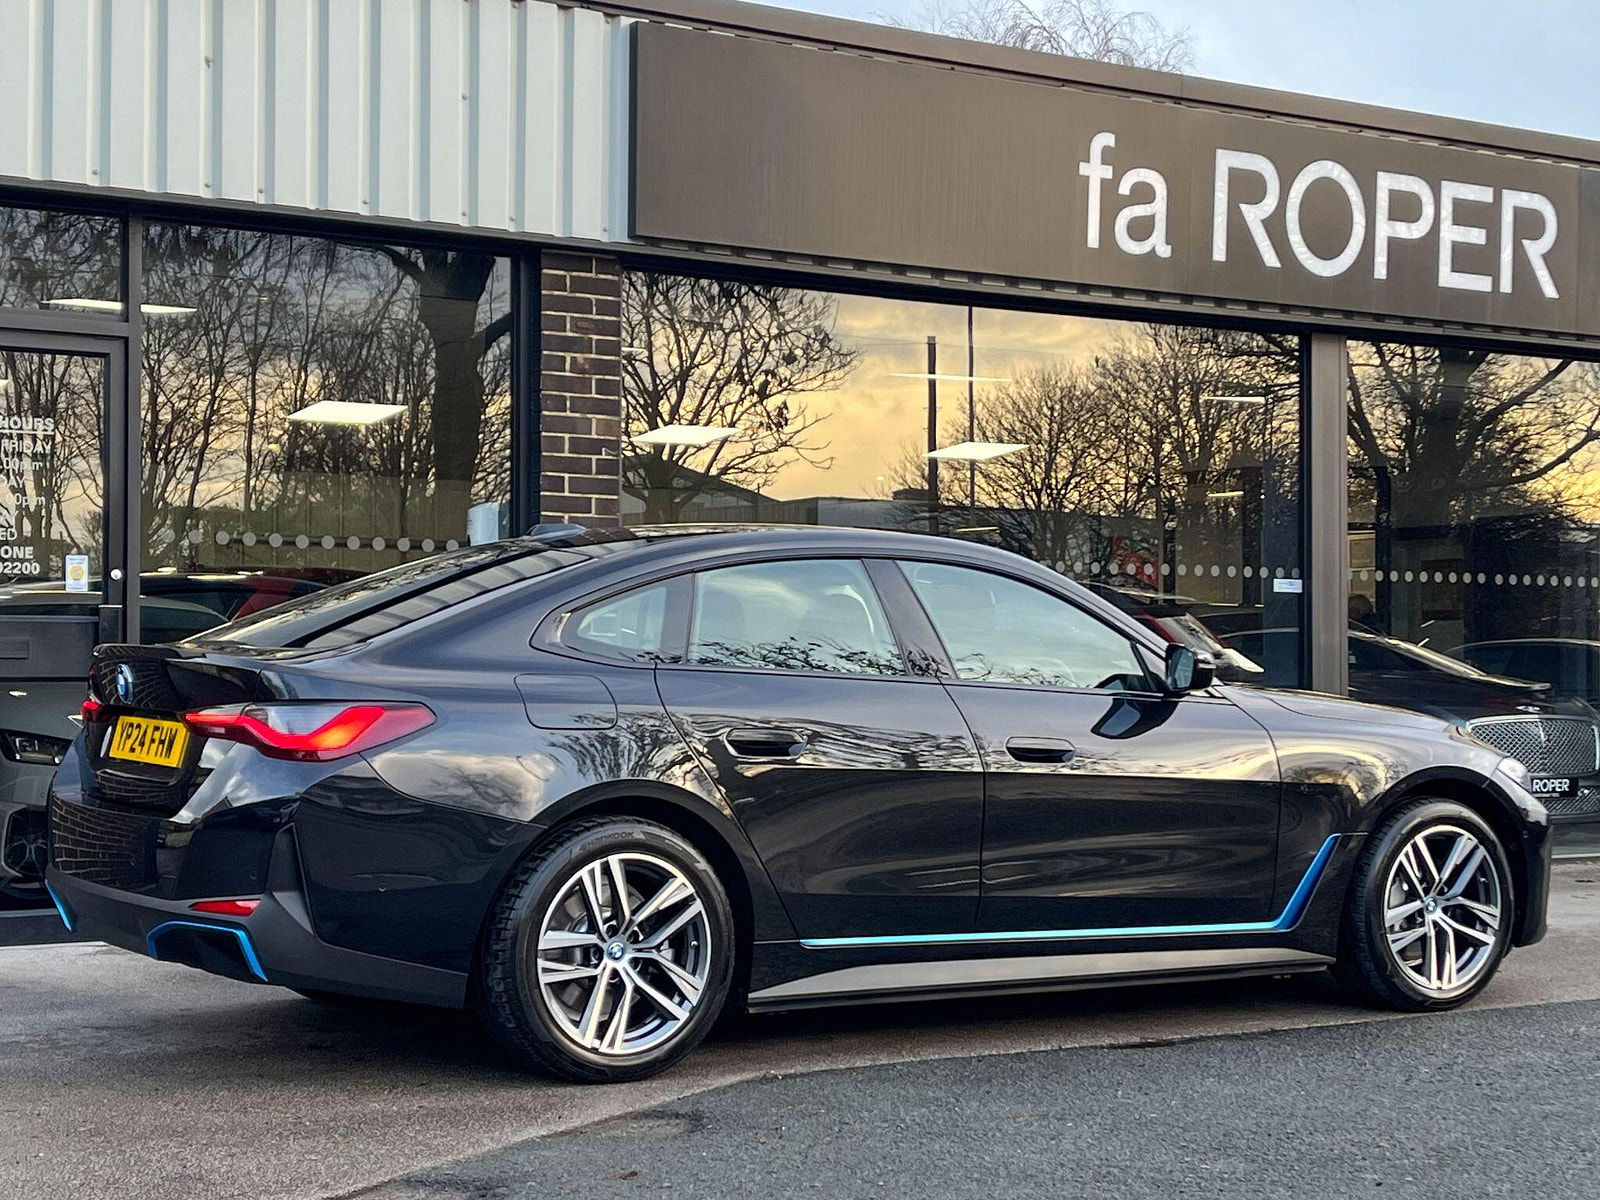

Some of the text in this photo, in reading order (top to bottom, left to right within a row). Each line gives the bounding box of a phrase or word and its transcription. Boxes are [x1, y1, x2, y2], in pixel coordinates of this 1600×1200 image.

[1078, 131, 1560, 299] fa ROPER
[0, 416, 55, 431] HOURS
[1, 439, 52, 454] FRIDAY
[0, 545, 34, 560] ONE
[117, 721, 148, 755] YP24
[1532, 779, 1570, 791] ROPER
